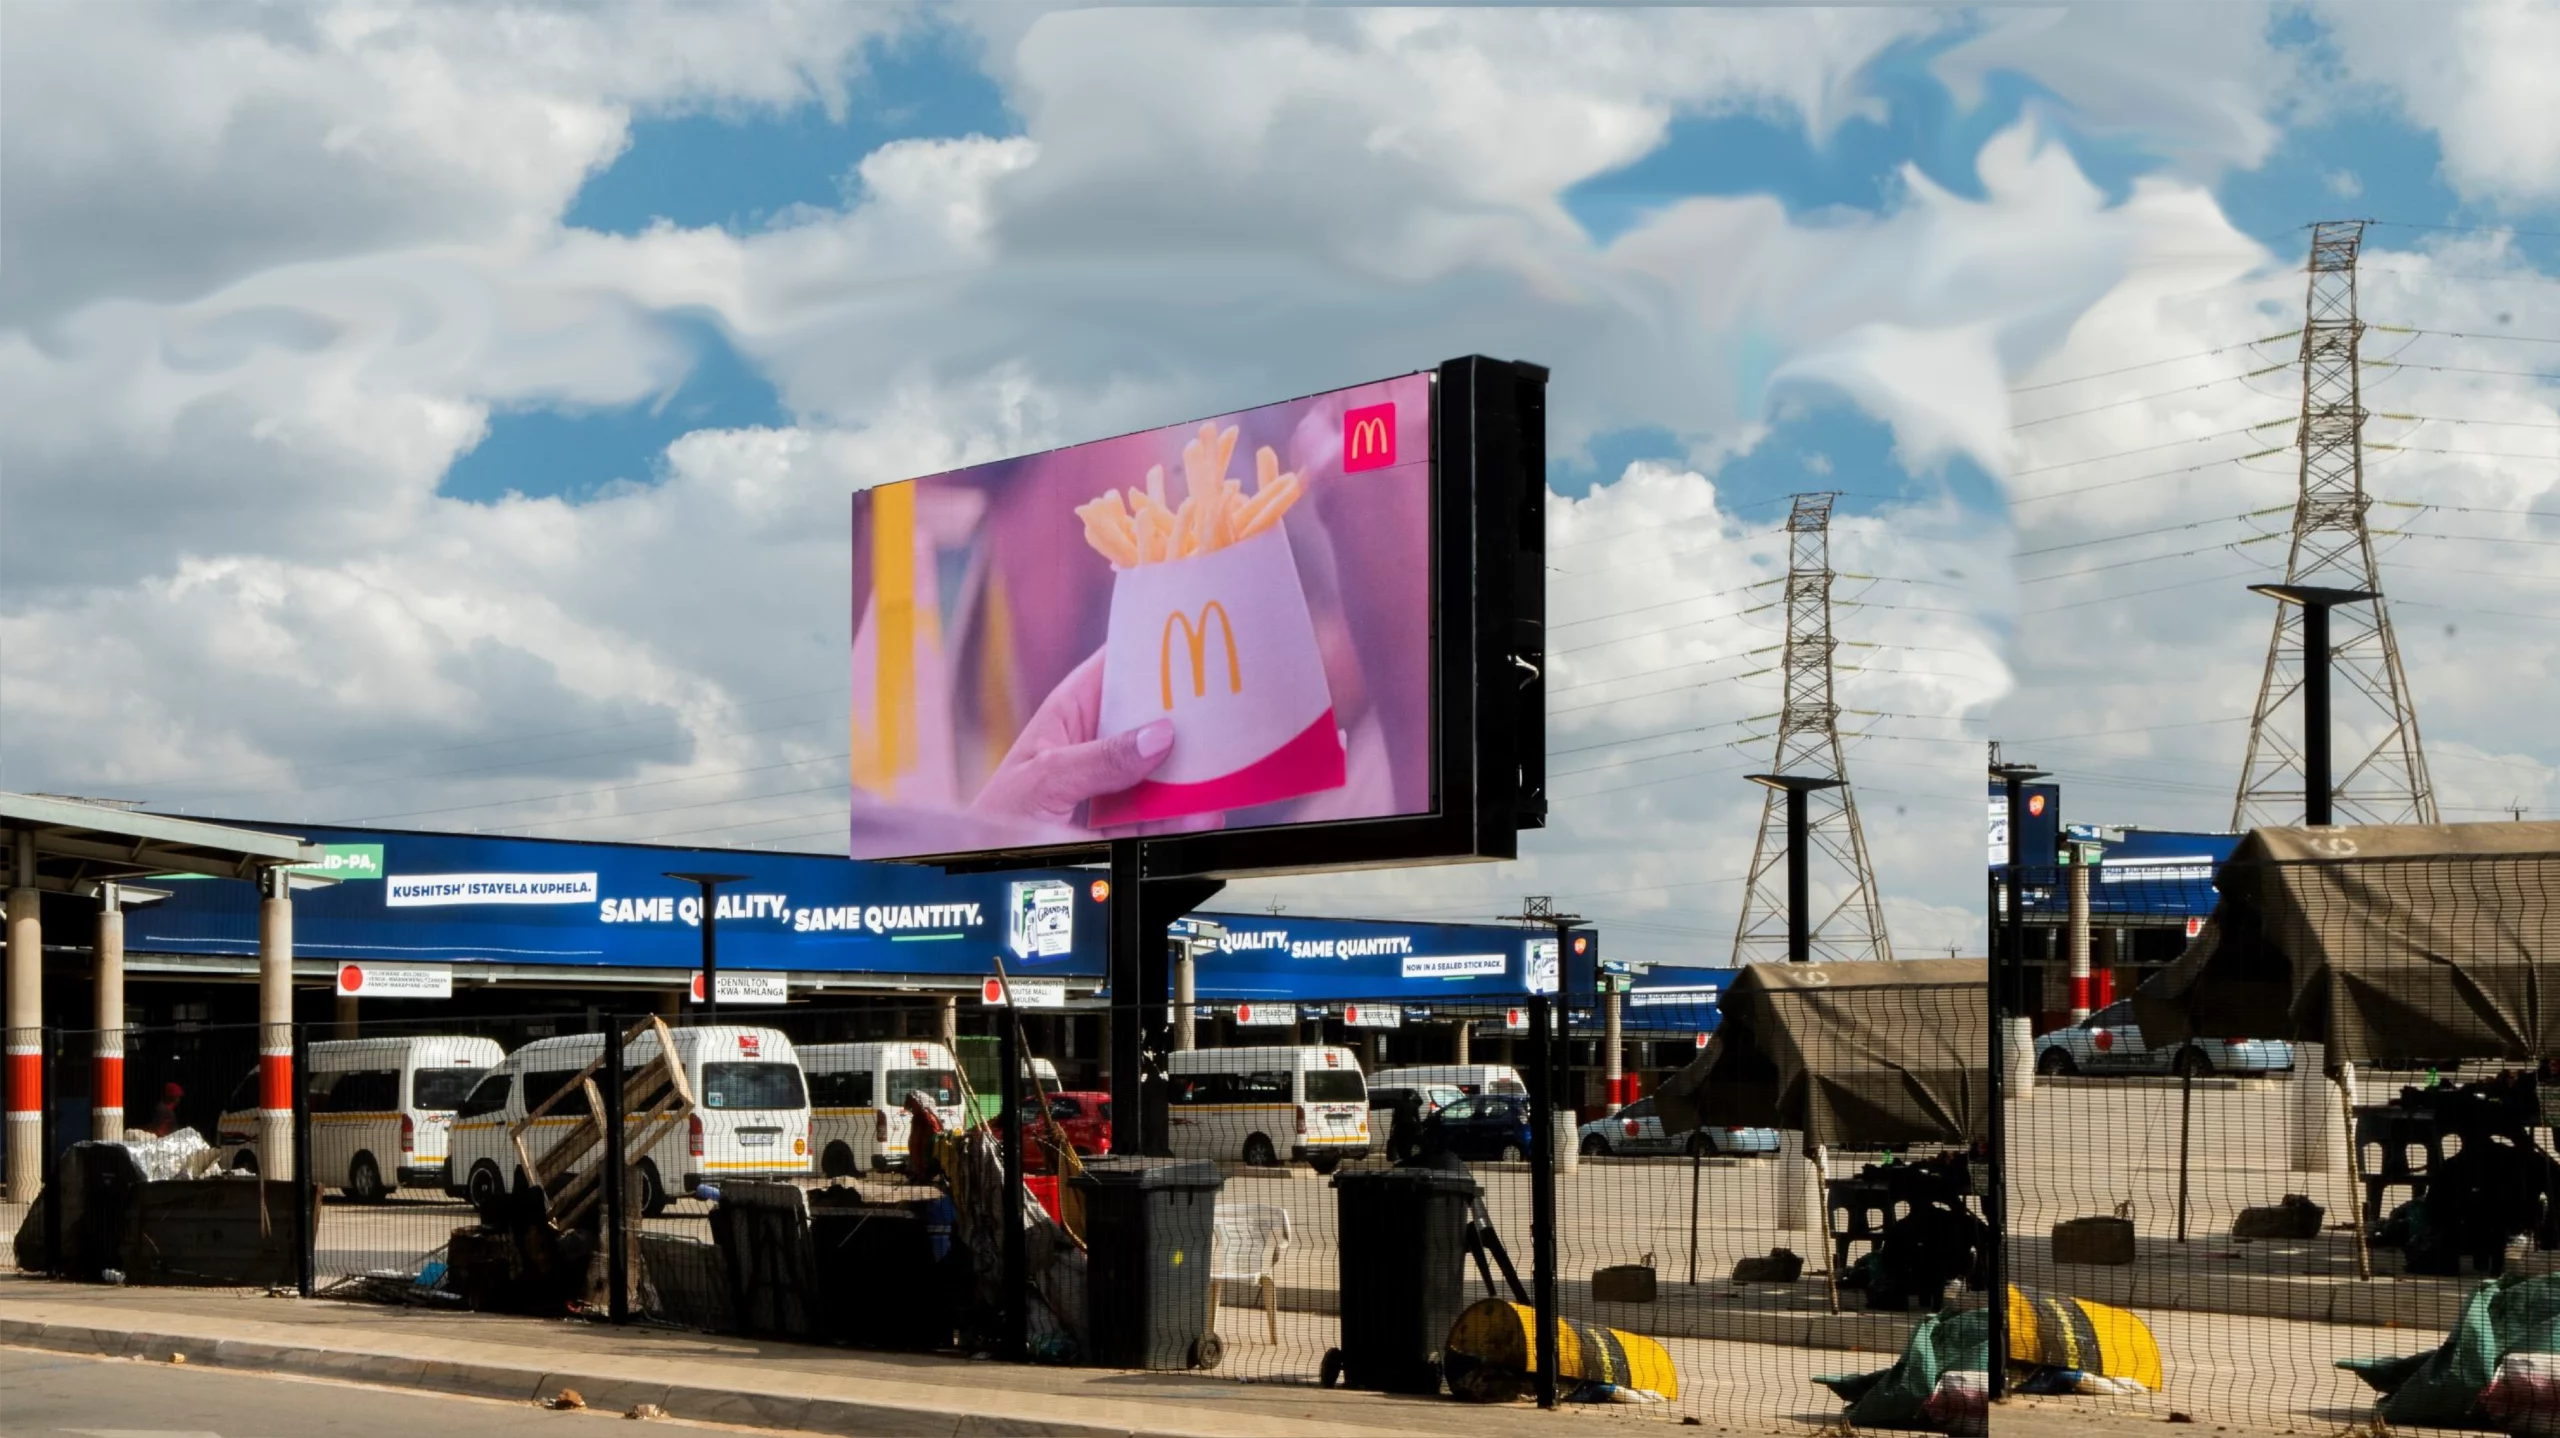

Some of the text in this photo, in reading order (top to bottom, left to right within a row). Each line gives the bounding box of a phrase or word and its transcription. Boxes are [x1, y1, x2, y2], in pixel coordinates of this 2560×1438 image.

[393, 882, 592, 898] KUSHITSH' ISTAYELA KUPHELA.
[601, 894, 791, 926] SAME QALITY,
[795, 902, 984, 934] SAME QUANTITY.
[1291, 936, 1413, 961] SAME QUANTITY.
[1437, 962, 1463, 970] SEALED
[1463, 961, 1482, 969] STICK
[1483, 960, 1502, 968] PACK.
[720, 978, 768, 987] DENNILTON
[743, 987, 784, 996] MHLANGA
